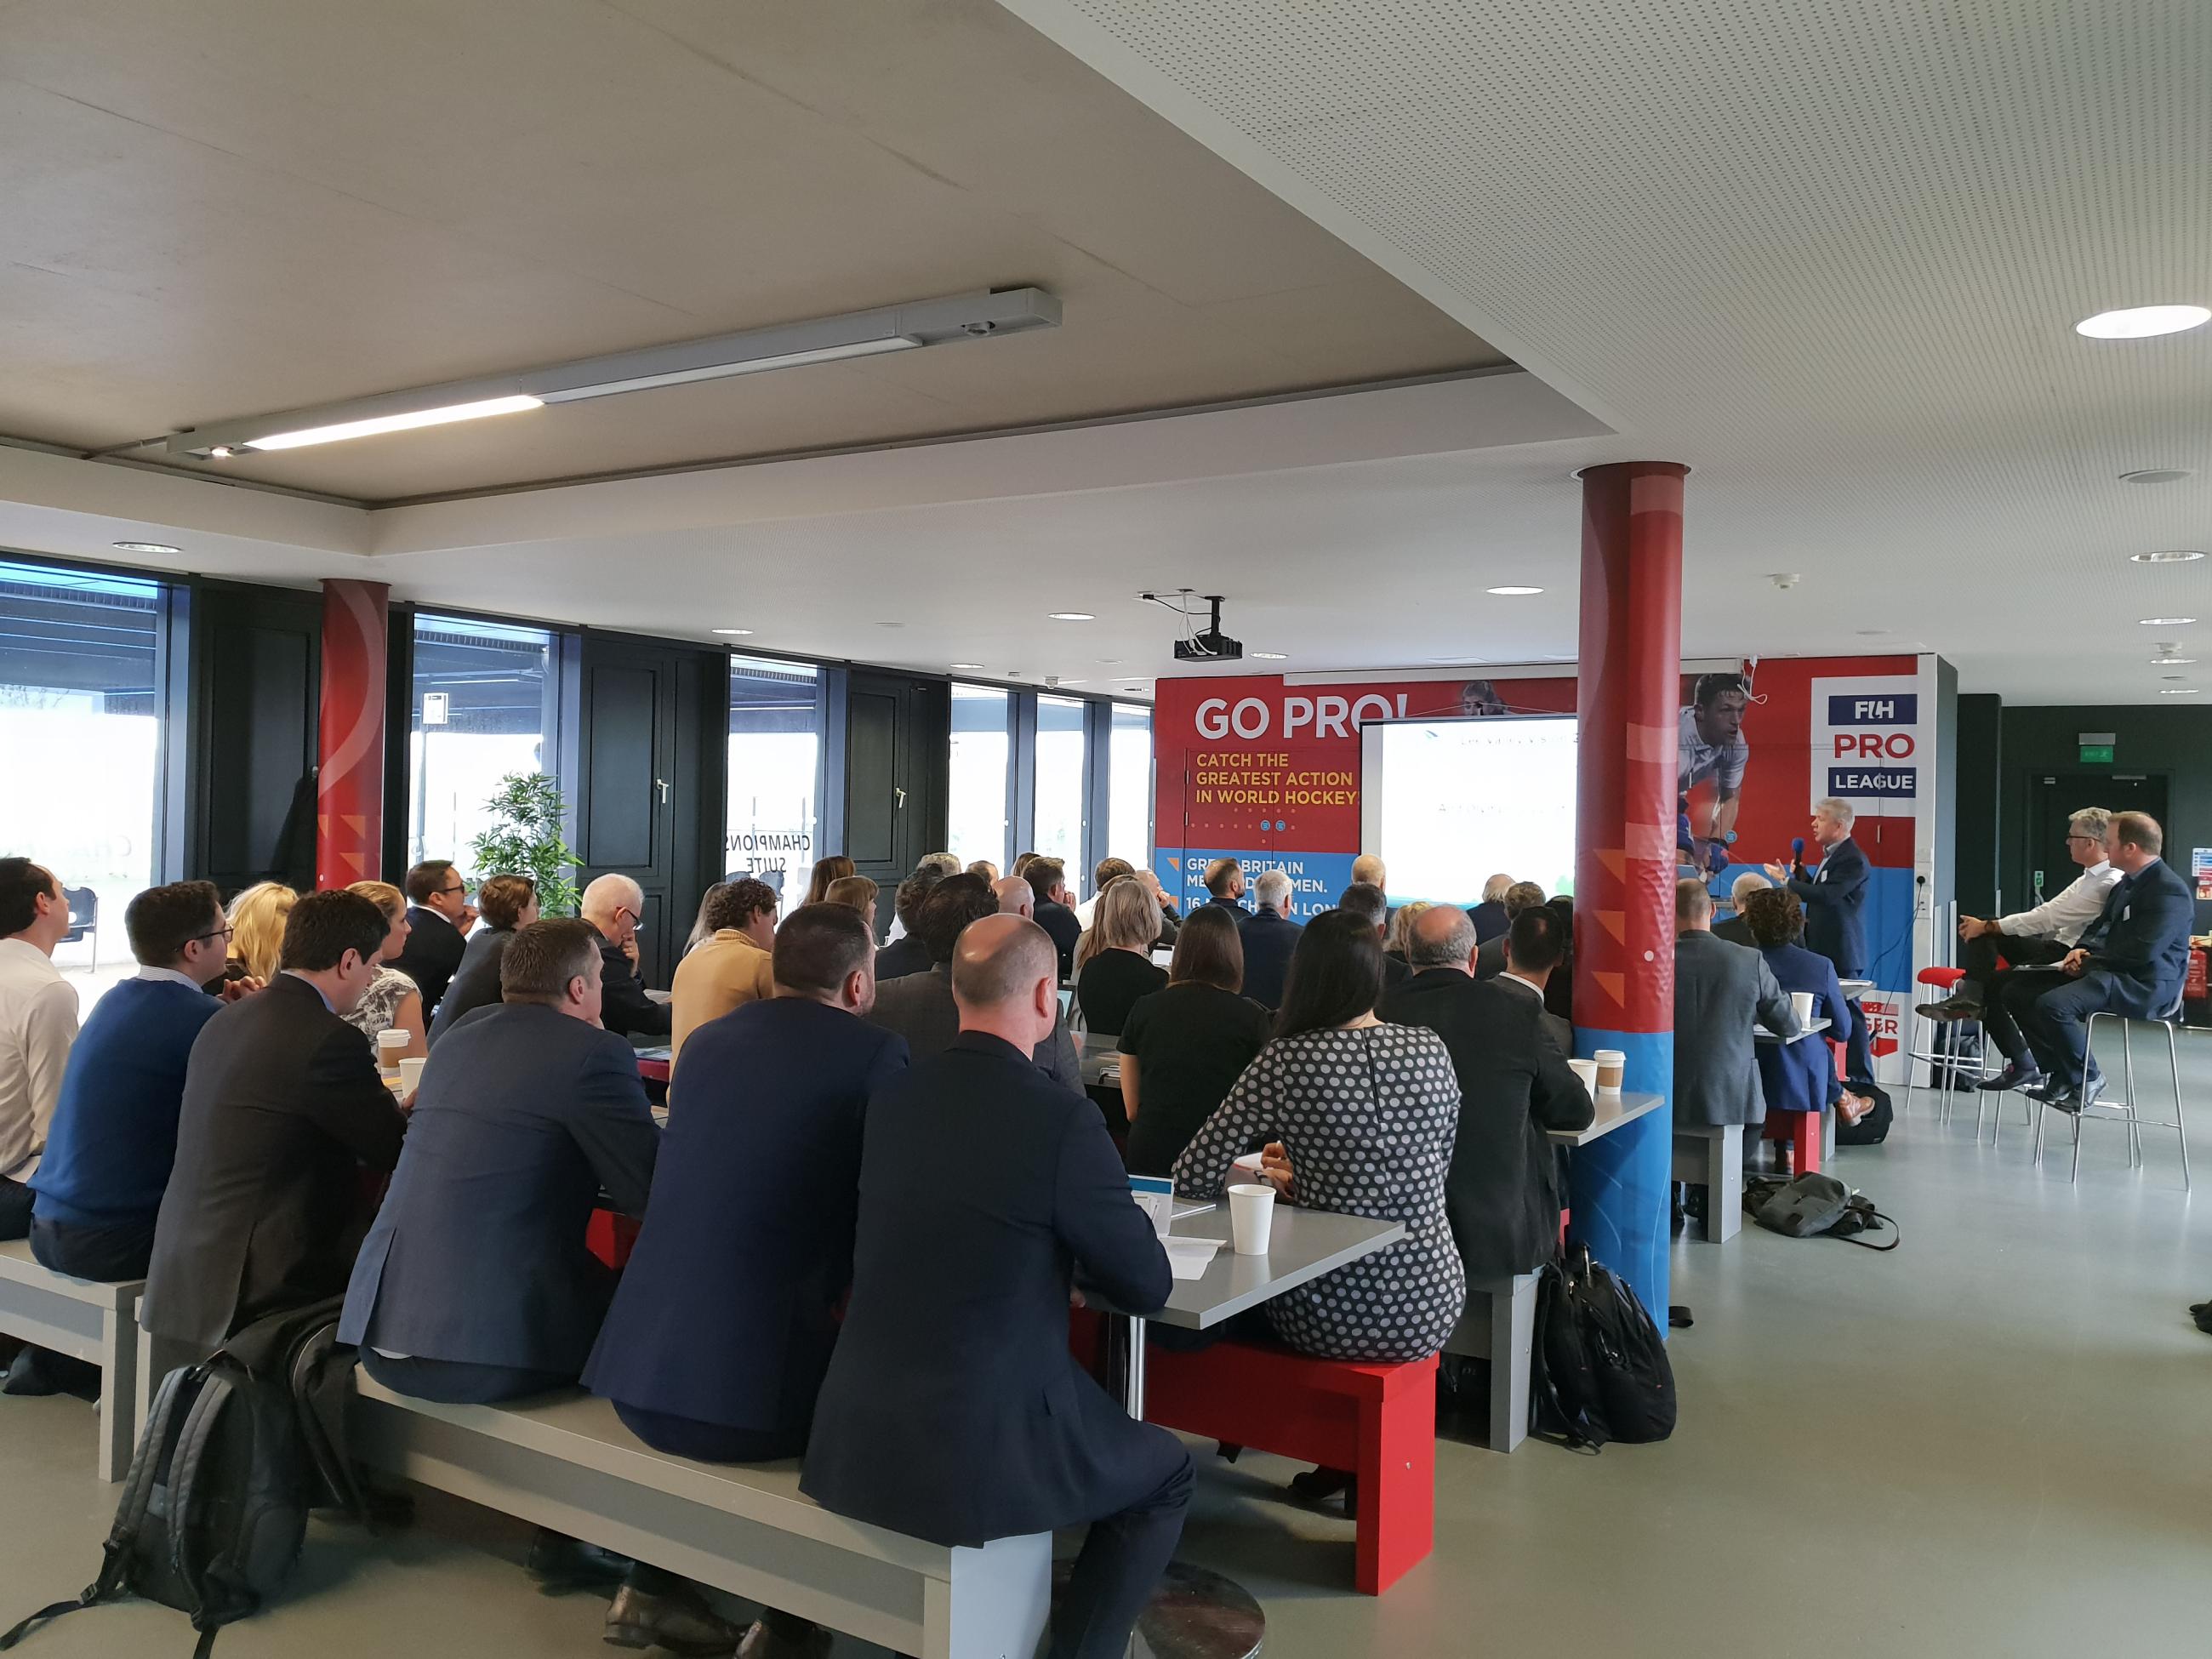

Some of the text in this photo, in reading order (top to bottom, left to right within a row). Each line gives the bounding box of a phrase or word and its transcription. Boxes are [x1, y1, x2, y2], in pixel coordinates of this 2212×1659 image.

[1195, 693, 1408, 739] GO PRO!
[1855, 700, 1894, 719] FIH
[1834, 733, 1915, 759] PRO
[1196, 753, 1289, 767] CATCH THE
[1196, 772, 1353, 786] GREATEST ACTION
[1835, 774, 1913, 790] LEAGUE
[1195, 790, 1358, 806] IN WORLD HOCKEY
[1241, 859, 1304, 875] BRITAIN
[1187, 875, 1208, 887] ME
[1185, 897, 1201, 909] 16
